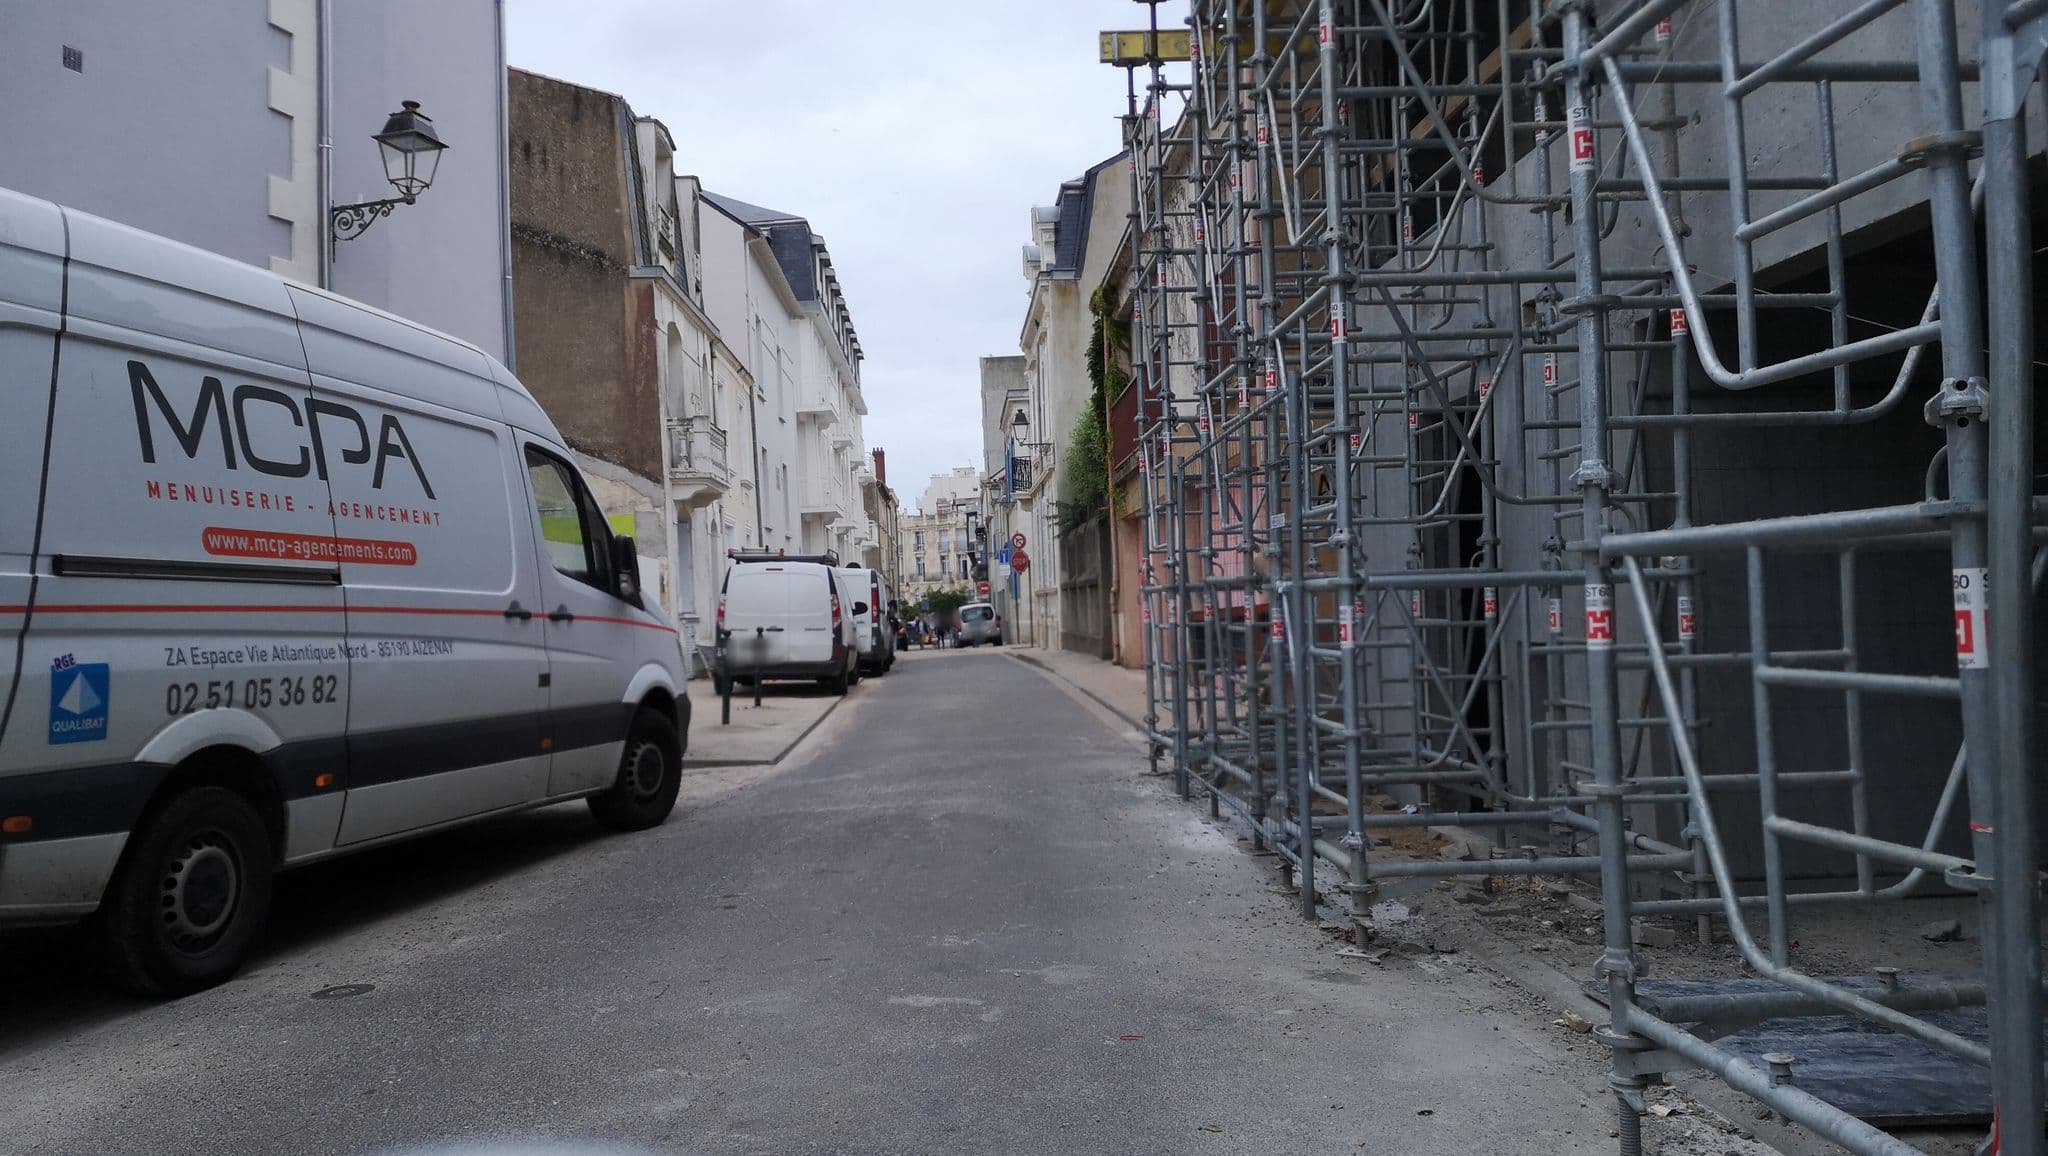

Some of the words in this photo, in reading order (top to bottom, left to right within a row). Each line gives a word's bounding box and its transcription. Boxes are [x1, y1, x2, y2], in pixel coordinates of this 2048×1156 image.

[127, 359, 437, 500] MCPA
[146, 479, 295, 512] MENUISERIE
[327, 500, 441, 527] AGENCEMENT
[207, 532, 413, 561] www.mcp-agencements.com
[54, 653, 76, 671] RGE
[165, 647, 187, 666] ZA
[191, 646, 243, 669] Espace
[245, 645, 267, 663] Vie
[272, 644, 336, 664] Atlantique
[338, 644, 368, 660] Nord
[378, 641, 410, 657] 85190
[412, 639, 454, 656] AIZENAY
[166, 682, 199, 716] 02
[206, 679, 234, 710] 51
[244, 677, 272, 709] 05
[278, 675, 305, 707] 36
[312, 673, 338, 704] 82
[52, 718, 105, 732] QUALIBAT
